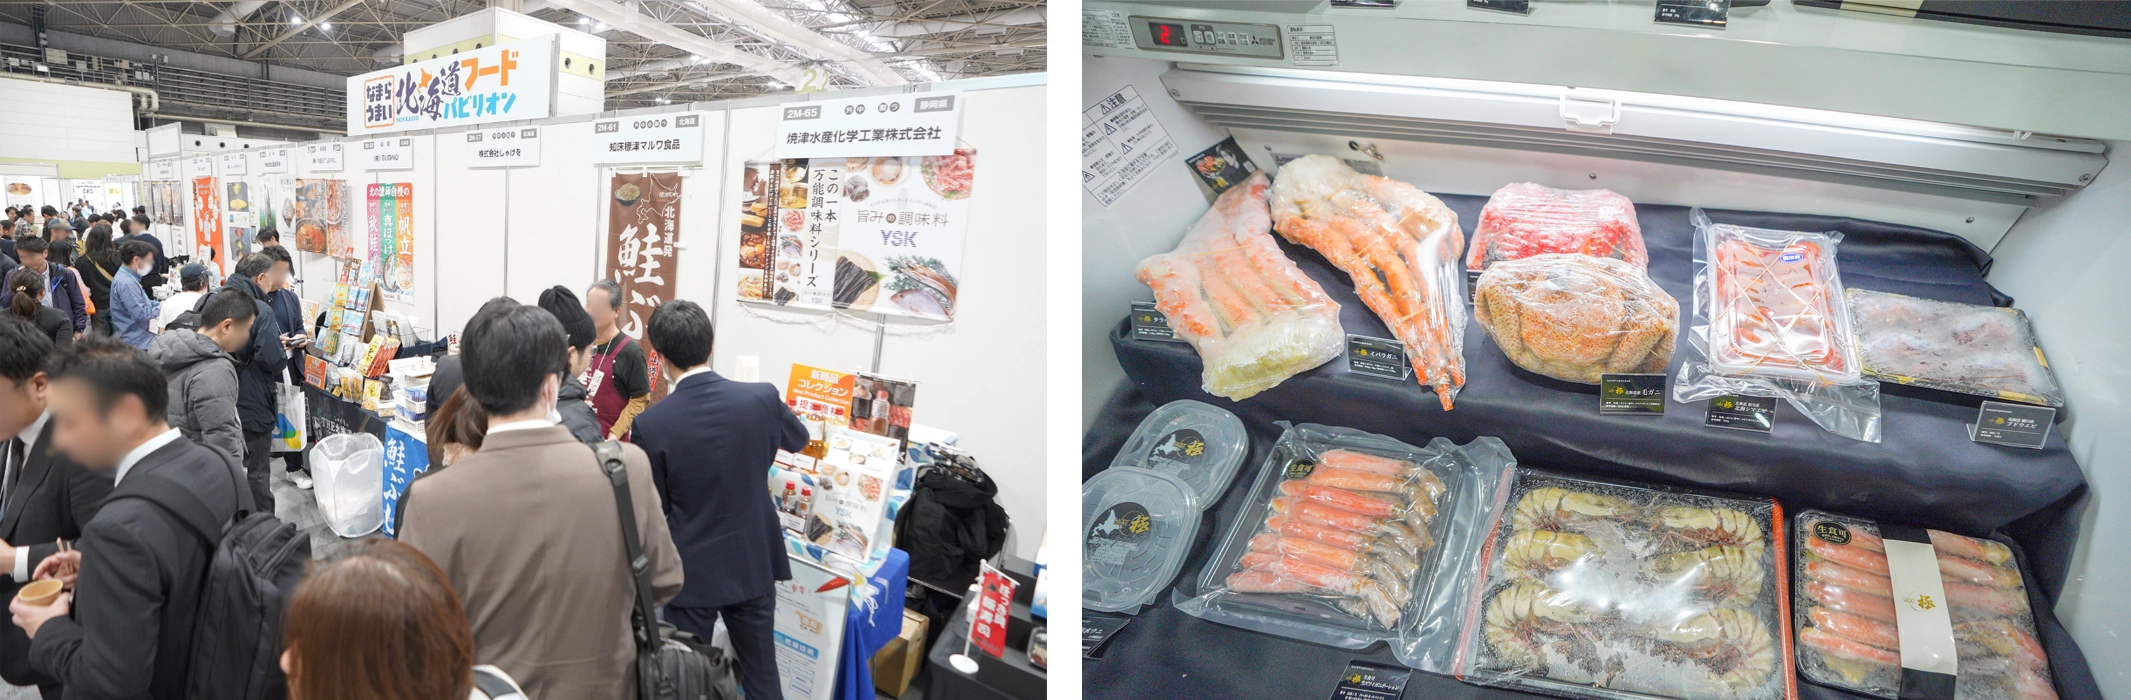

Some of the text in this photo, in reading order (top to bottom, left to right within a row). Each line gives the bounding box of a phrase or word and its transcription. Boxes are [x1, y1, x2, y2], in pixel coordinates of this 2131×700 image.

[1160, 25, 1170, 44] 2
[395, 49, 520, 122] 北海道 フード
[801, 69, 818, 93] 2
[366, 81, 392, 103] なまら
[443, 91, 517, 120] パビリオン
[919, 99, 948, 110] 静岡県
[1106, 93, 1127, 110] 注意
[366, 102, 393, 122] うまい
[396, 115, 420, 123] HOKKAIDO
[787, 108, 818, 119] 2M-65
[597, 124, 616, 132] 2M-61
[679, 118, 696, 126] 北海道
[786, 126, 942, 145] 焼津水産化学工業株式会社
[478, 148, 522, 158] 株式会社しゃけを
[609, 139, 681, 152] 知床標津マルワ食品
[823, 169, 839, 223] この一本
[857, 208, 949, 228] 旨みの調味料
[382, 214, 394, 255] 真ほっけ
[398, 215, 412, 255] 帆立
[663, 206, 676, 257] 北海道発
[806, 169, 826, 288] 万能調味料シリーズ
[880, 229, 918, 248] YSK
[810, 369, 840, 385] 新商品
[797, 379, 849, 397] コレクション
[1642, 388, 1661, 396] 毛ガニ
[804, 390, 825, 400] Product
[825, 395, 851, 405] Collection
[2006, 421, 2038, 429] ブドウエビ
[1185, 440, 1204, 457] 極
[835, 506, 853, 519] YSK
[1129, 514, 1150, 534] 極
[1817, 525, 1847, 538] 生食可
[1917, 594, 1937, 611] 極
